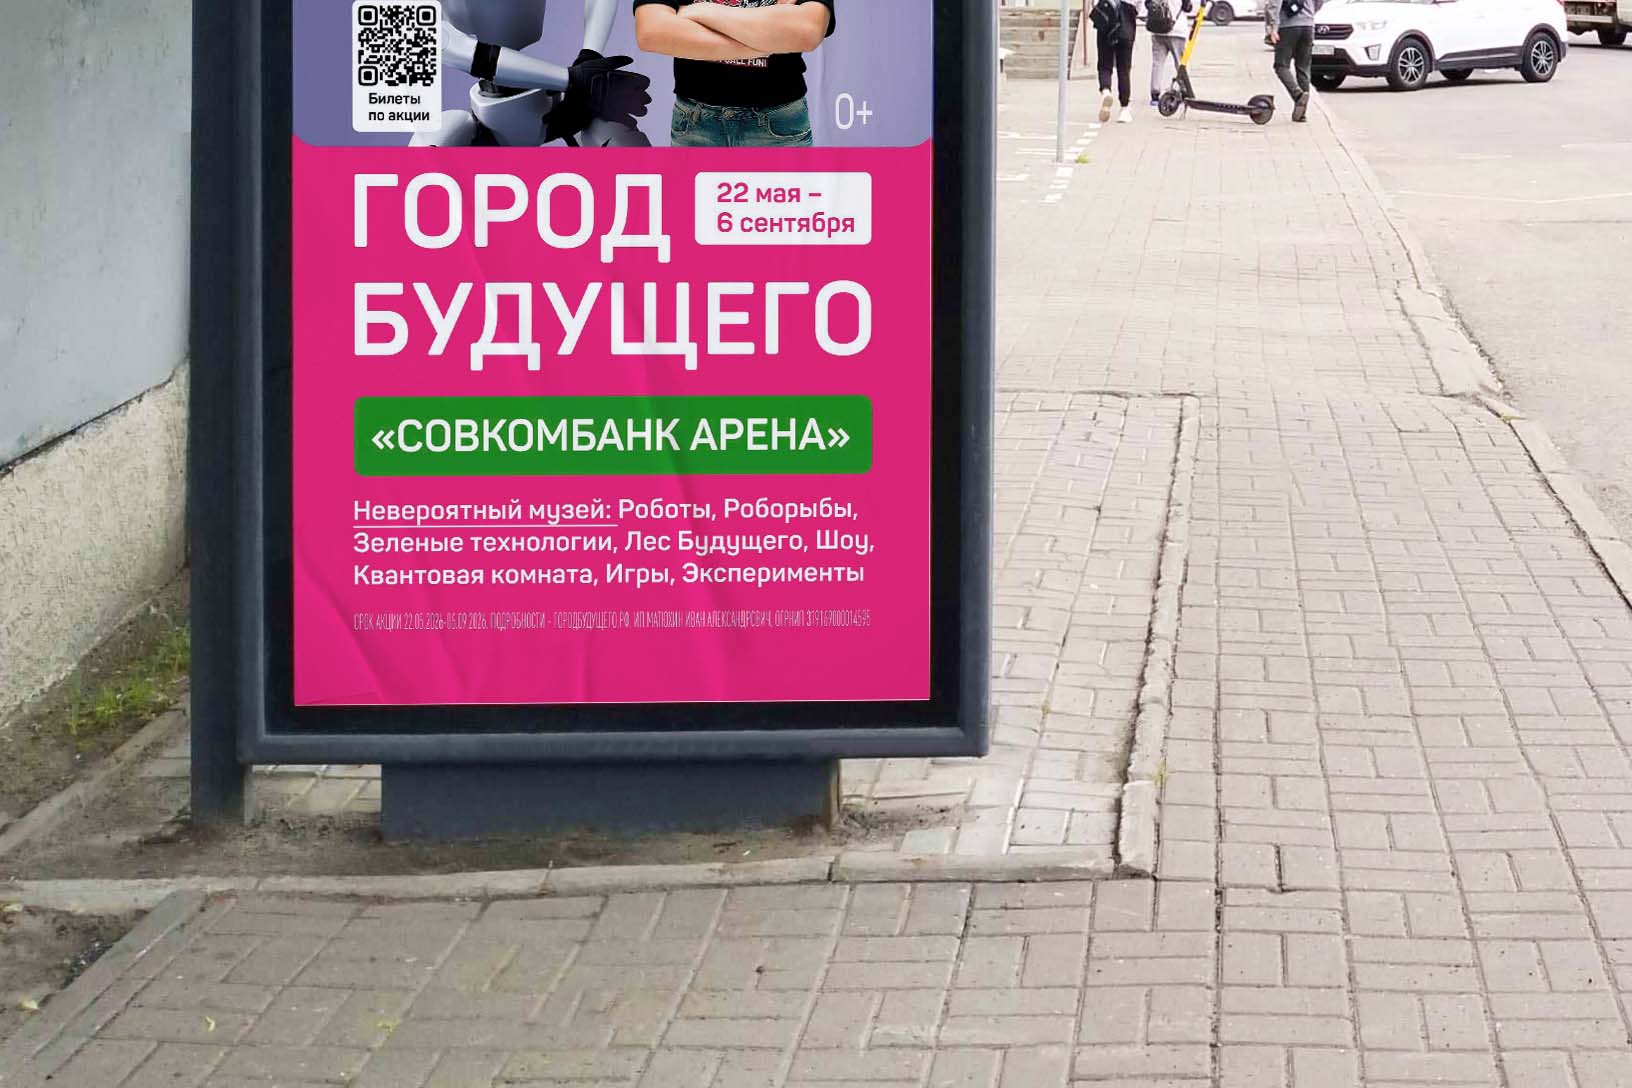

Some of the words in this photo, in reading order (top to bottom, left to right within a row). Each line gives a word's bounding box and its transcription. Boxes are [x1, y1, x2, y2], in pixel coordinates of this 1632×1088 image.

[368, 92, 421, 105] Билеты
[834, 91, 874, 131] 0+
[368, 111, 385, 121] по
[388, 111, 430, 123] акции
[716, 181, 749, 203] 22
[755, 187, 801, 204] мая
[353, 172, 671, 263] ГОРОД
[717, 211, 733, 233] 6
[739, 211, 855, 238] сентября
[353, 279, 872, 371] БУДУЩЕГО
[371, 418, 681, 453] «СОВКОМБАНК
[689, 417, 850, 451] АРЕНА»
[353, 499, 521, 524] Невероятный
[529, 499, 612, 523] музей:
[618, 497, 717, 521] Роботы,
[724, 497, 858, 523] Роборыбы,
[353, 531, 464, 553] Зеленые
[470, 535, 618, 555] технологии,
[625, 531, 671, 552] Лес
[678, 530, 809, 557] Будущего,
[816, 530, 875, 556] Шоу,
[353, 564, 484, 585] Квантовая
[491, 568, 598, 587] комната,
[606, 564, 675, 589] Игры,
[682, 563, 864, 588] Эксперименты
